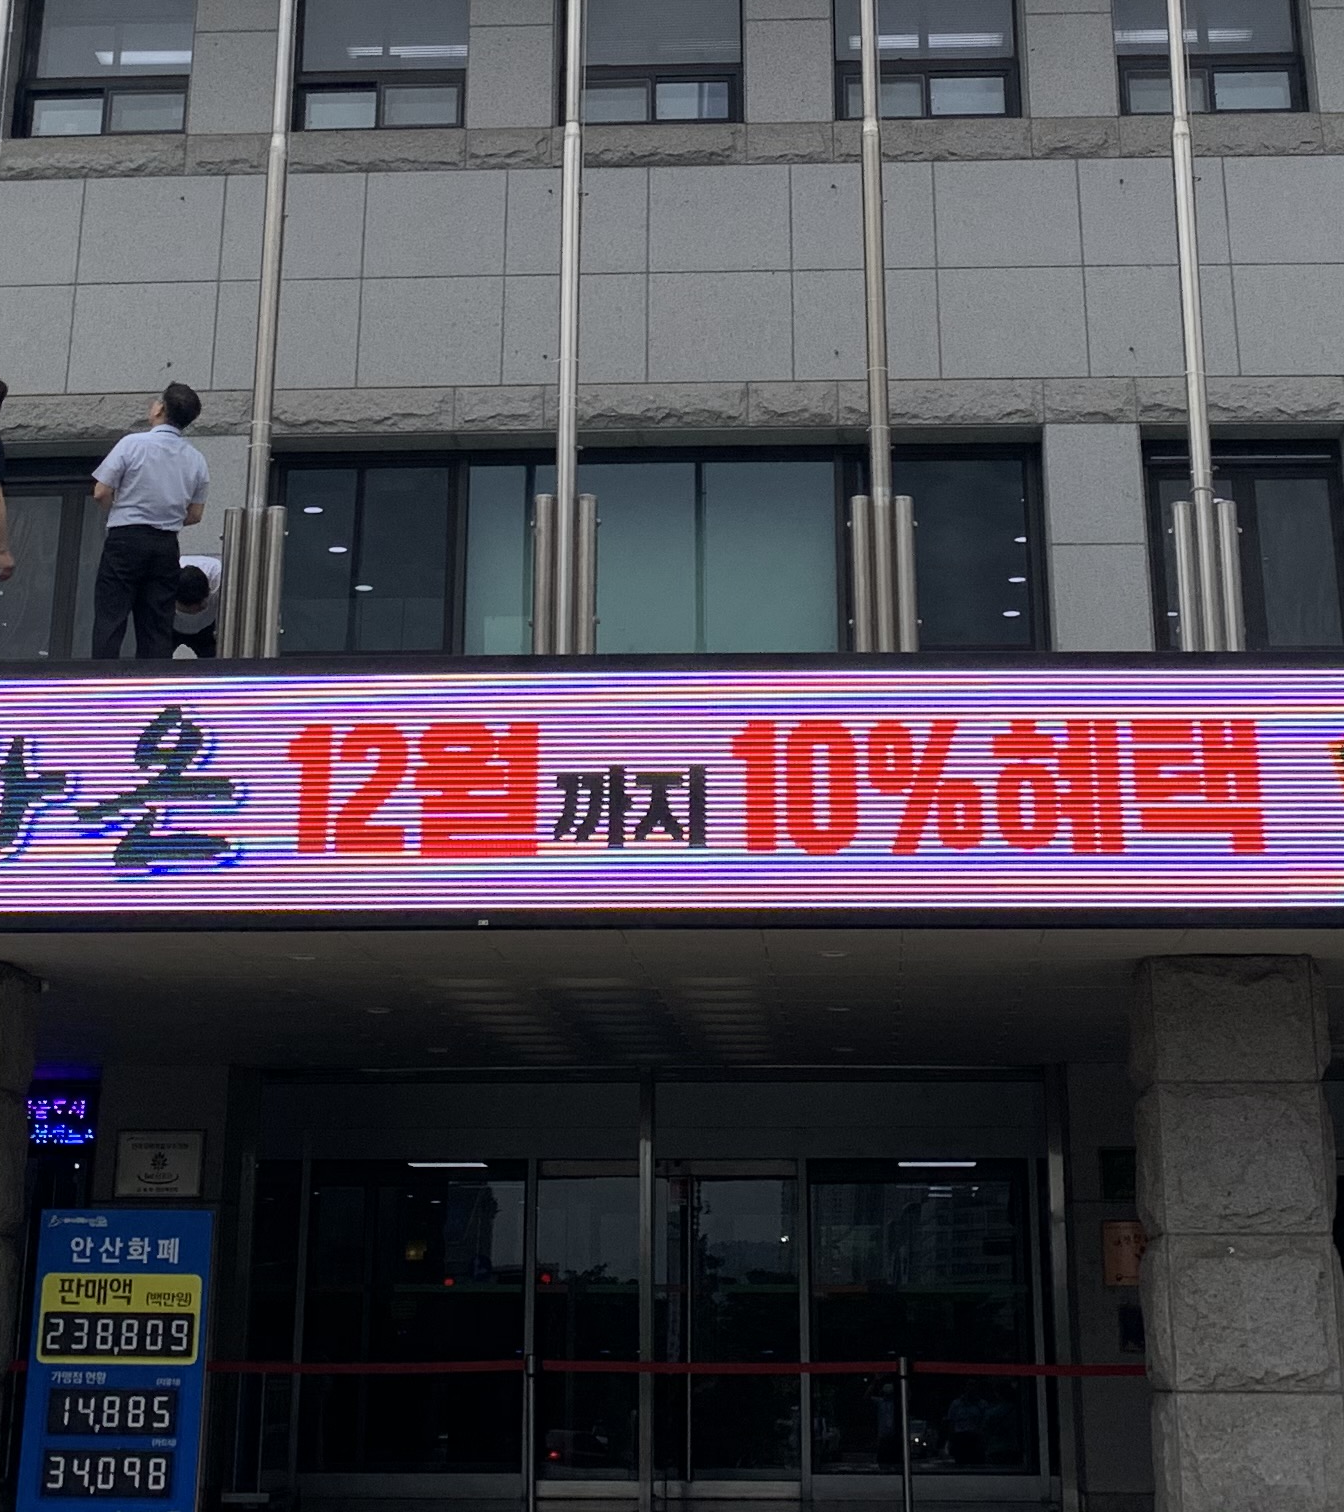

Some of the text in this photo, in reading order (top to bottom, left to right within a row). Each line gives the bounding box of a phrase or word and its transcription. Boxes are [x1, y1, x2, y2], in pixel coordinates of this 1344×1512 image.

[70, 1236, 180, 1265] 안산화폐
[58, 1278, 193, 1307] 판매액 (백만원)
[46, 1318, 189, 1356] 238,809
[51, 1371, 107, 1385] 가맹점 현황
[63, 1396, 171, 1434] 14,885
[46, 1456, 167, 1495] 34,098
